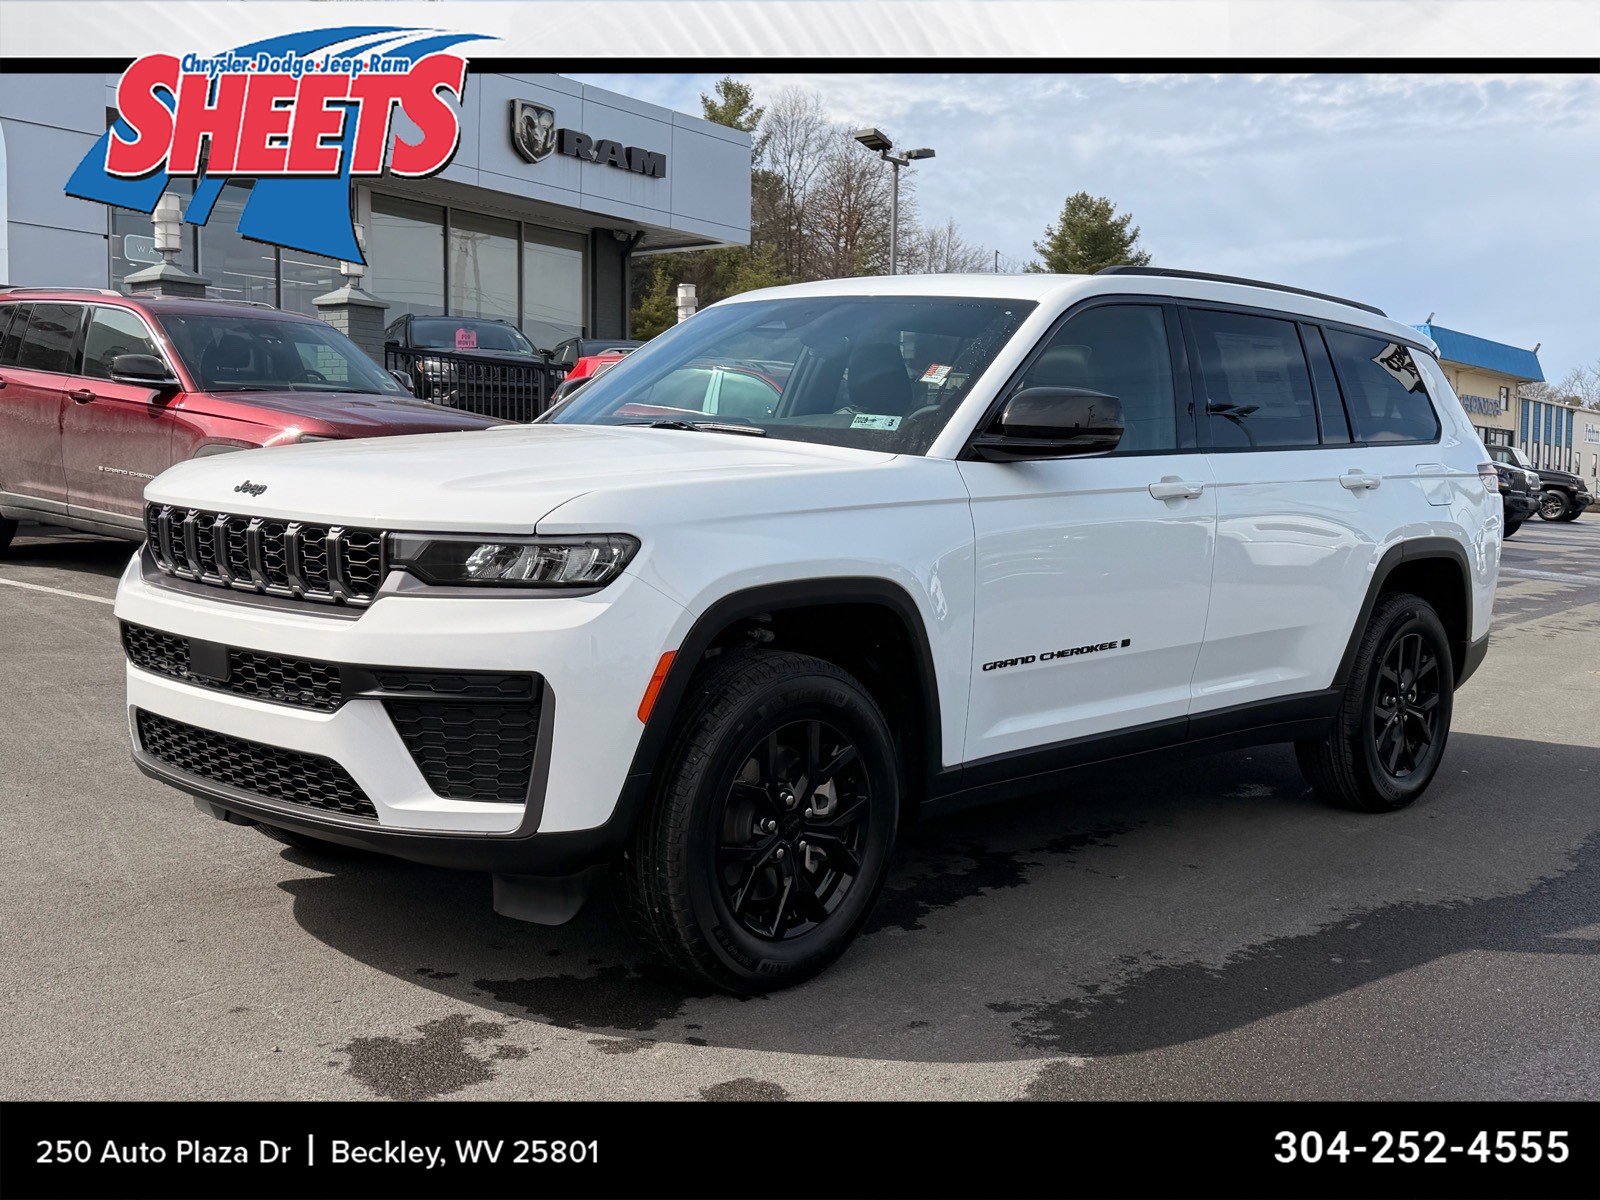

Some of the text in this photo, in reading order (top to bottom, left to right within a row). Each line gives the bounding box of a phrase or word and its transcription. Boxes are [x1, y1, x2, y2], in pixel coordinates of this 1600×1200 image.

[557, 128, 666, 178] RAM
[234, 480, 268, 498] Jeep
[982, 654, 1036, 672] GRAND
[1039, 640, 1118, 662] CHEROKEE
